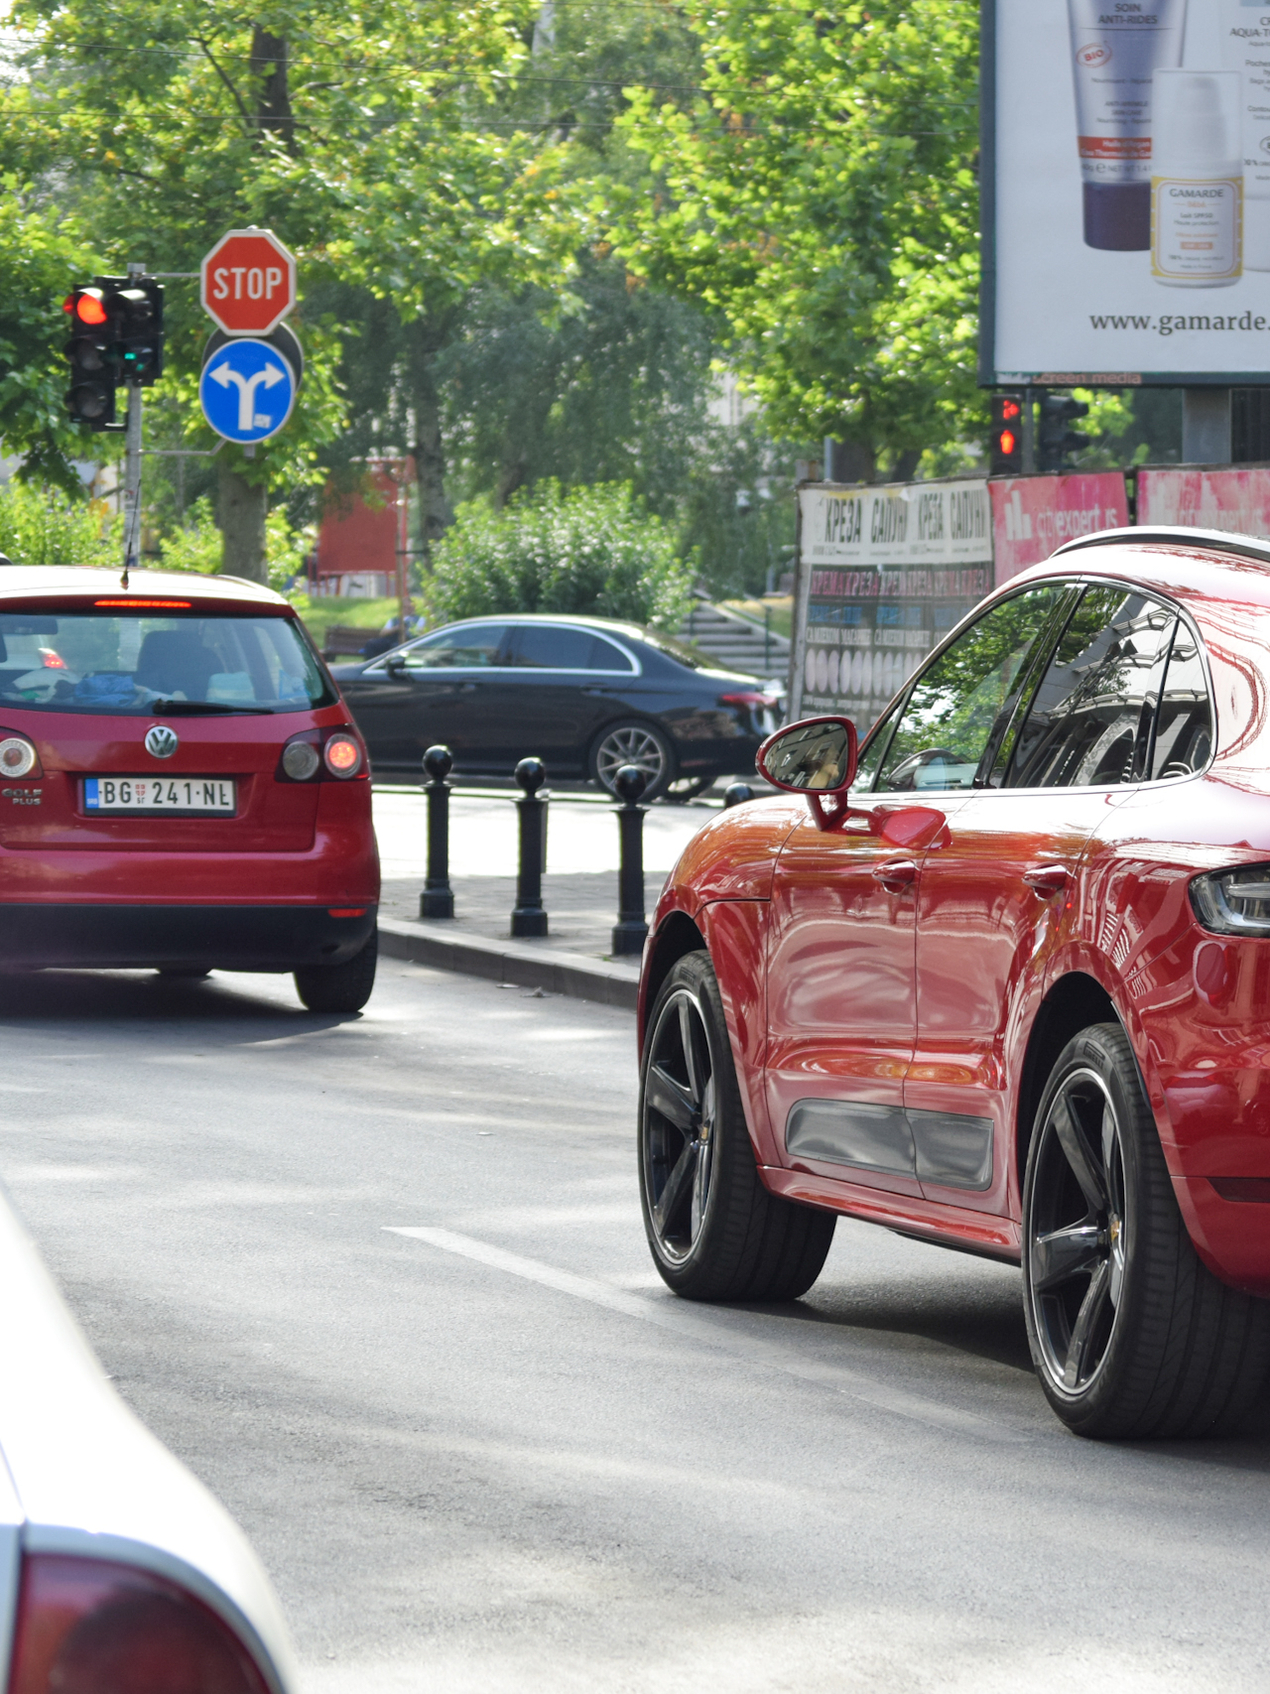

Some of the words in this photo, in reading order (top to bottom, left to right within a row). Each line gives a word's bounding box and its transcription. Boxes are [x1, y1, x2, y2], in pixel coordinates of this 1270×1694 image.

[1115, 3, 1141, 12] SOIN
[1098, 15, 1158, 24] ANTI-RIDES
[1084, 49, 1104, 62] BIO
[1169, 188, 1224, 198] GAMARDE
[213, 267, 282, 300] STOP
[1092, 372, 1142, 384] media
[825, 498, 862, 543] КРЕЗА
[2, 788, 42, 798] GOLF
[104, 781, 132, 805] BG
[12, 797, 41, 806] PLUS
